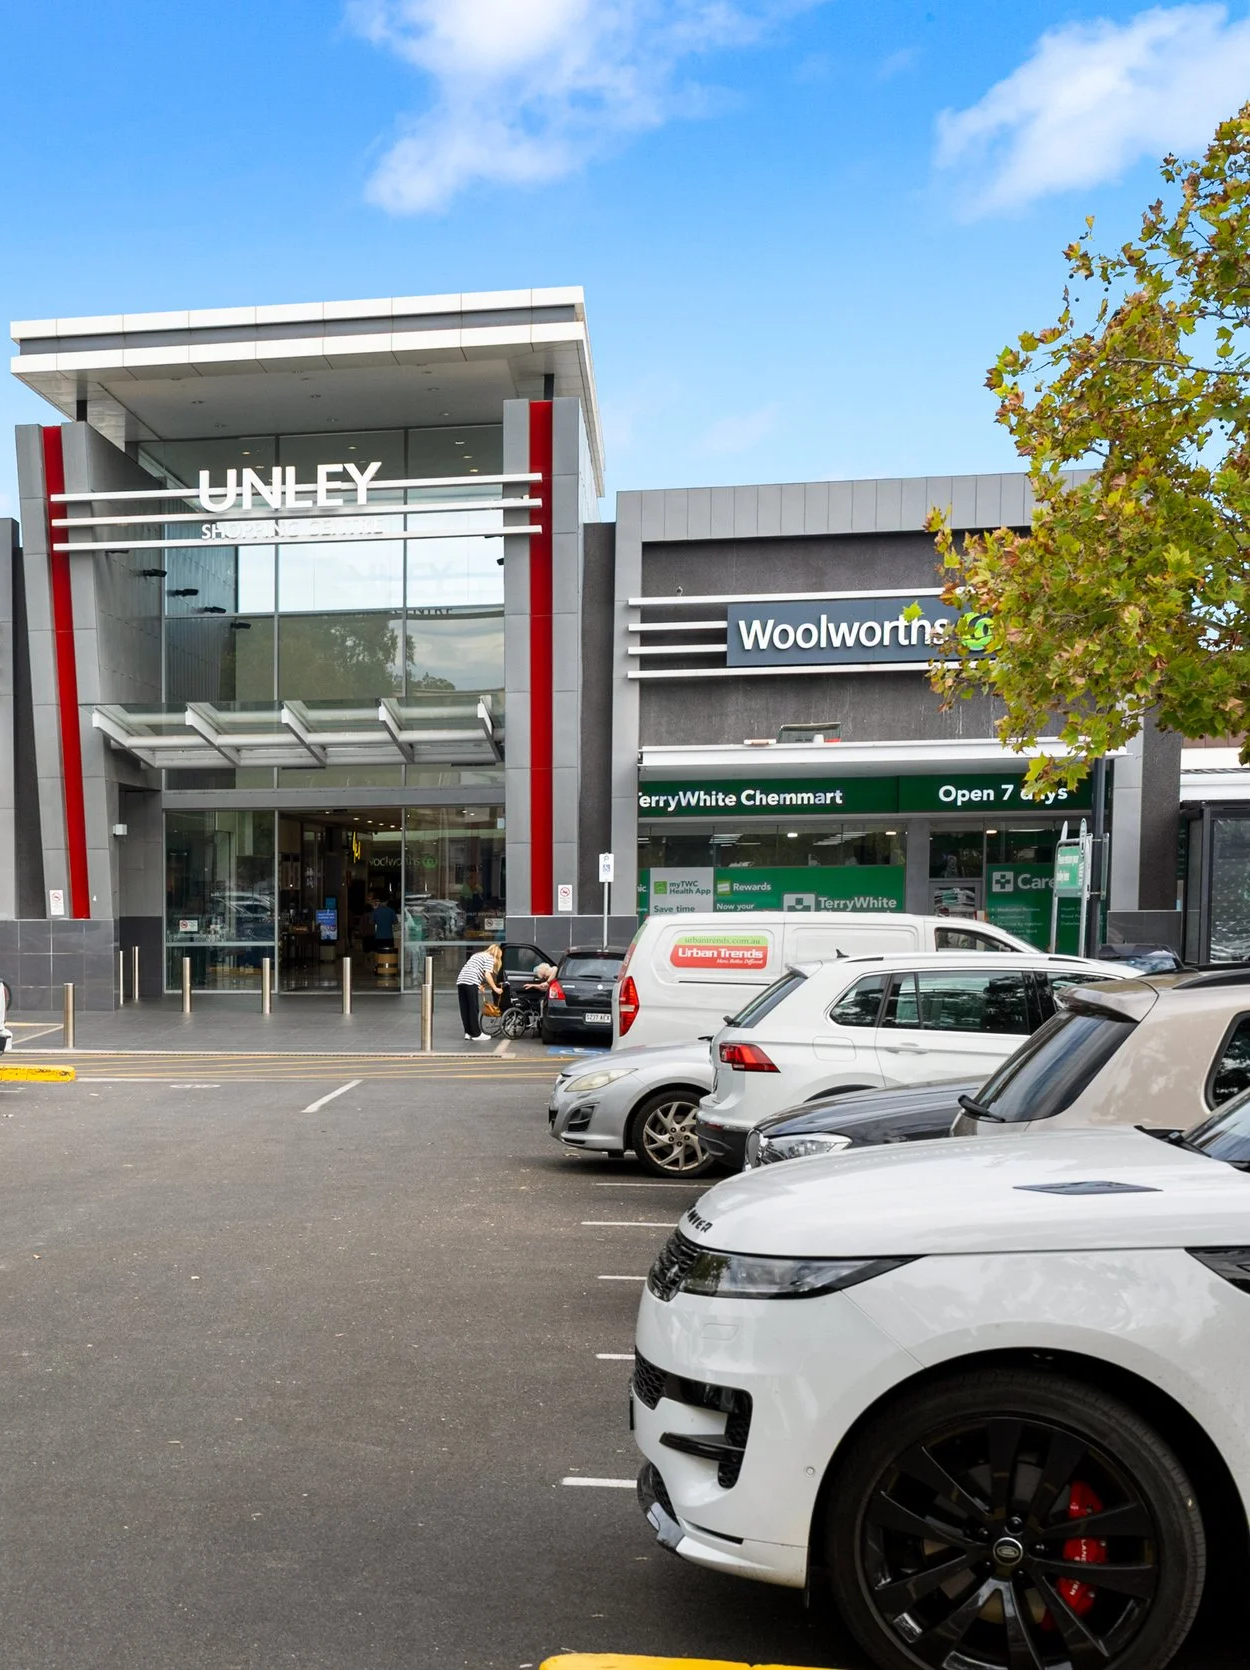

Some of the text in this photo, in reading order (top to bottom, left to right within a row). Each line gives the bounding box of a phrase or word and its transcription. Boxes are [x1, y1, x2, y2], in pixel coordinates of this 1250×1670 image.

[199, 462, 382, 512] UNLEY
[201, 520, 299, 540] SHOPPING
[738, 614, 949, 650] Woolworths
[638, 789, 844, 812] erryWhite Chemmart
[938, 785, 995, 806] Open
[1001, 784, 1014, 800] 7
[695, 888, 711, 896] App
[733, 882, 771, 891] Rewards
[654, 905, 674, 913] Save
[676, 905, 695, 913] time
[737, 903, 754, 911] your
[818, 896, 897, 911] TerryWhite
[684, 937, 762, 945] urbantrends.com.au
[678, 948, 763, 958] Urban Trends
